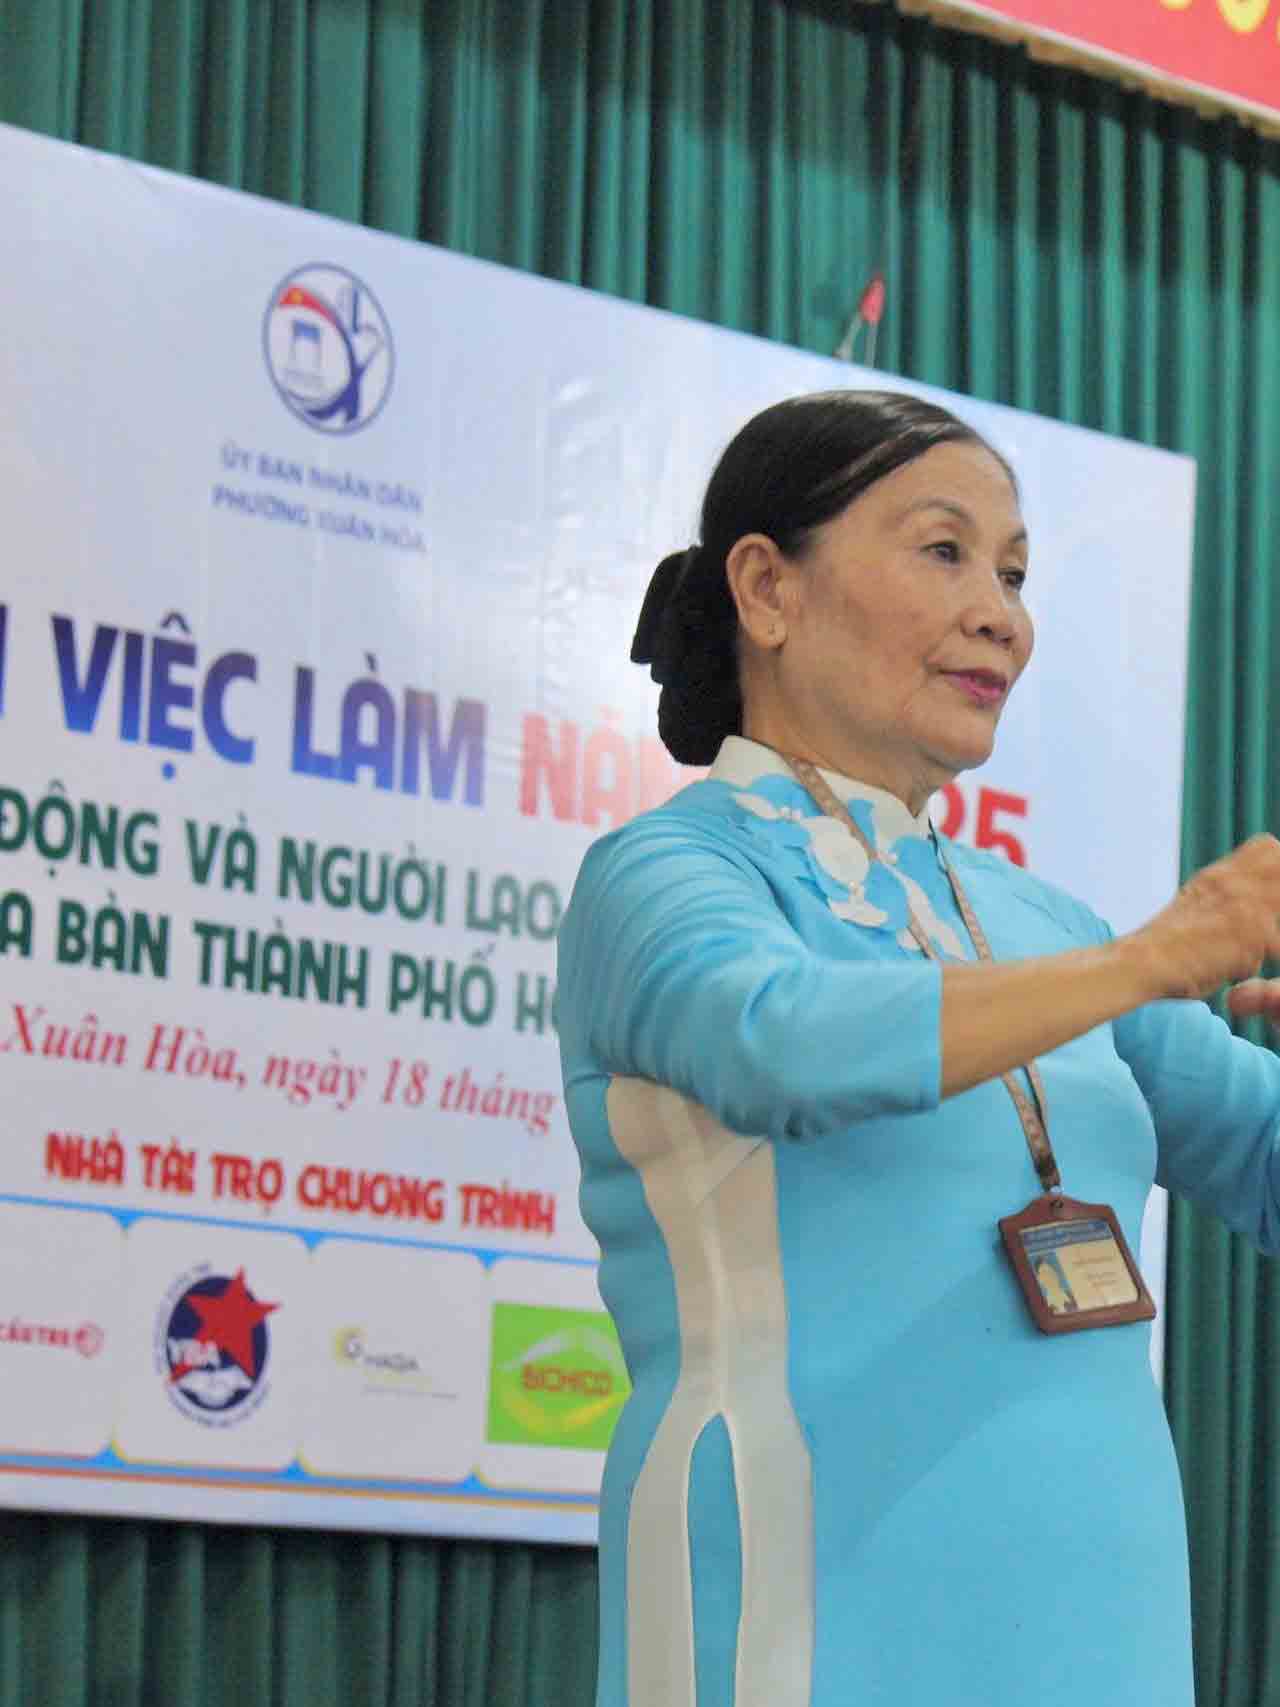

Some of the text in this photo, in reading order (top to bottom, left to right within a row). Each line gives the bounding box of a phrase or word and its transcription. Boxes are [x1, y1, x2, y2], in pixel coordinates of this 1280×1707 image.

[51, 611, 257, 780] VIỆC
[291, 651, 485, 807] LÀM
[0, 779, 561, 941] ĐỘNG VÀ NGƯỜI LAO
[57, 888, 170, 979] BÀN
[193, 915, 369, 1008] THÀNH
[388, 942, 497, 1027] PHỐ
[514, 968, 560, 1035] H
[0, 1001, 556, 1136] Xuân Hòa, ngày 18 tháng
[45, 1129, 557, 1234] NHÀ TÀI TRỢ CHƯƠNG TRÌNH
